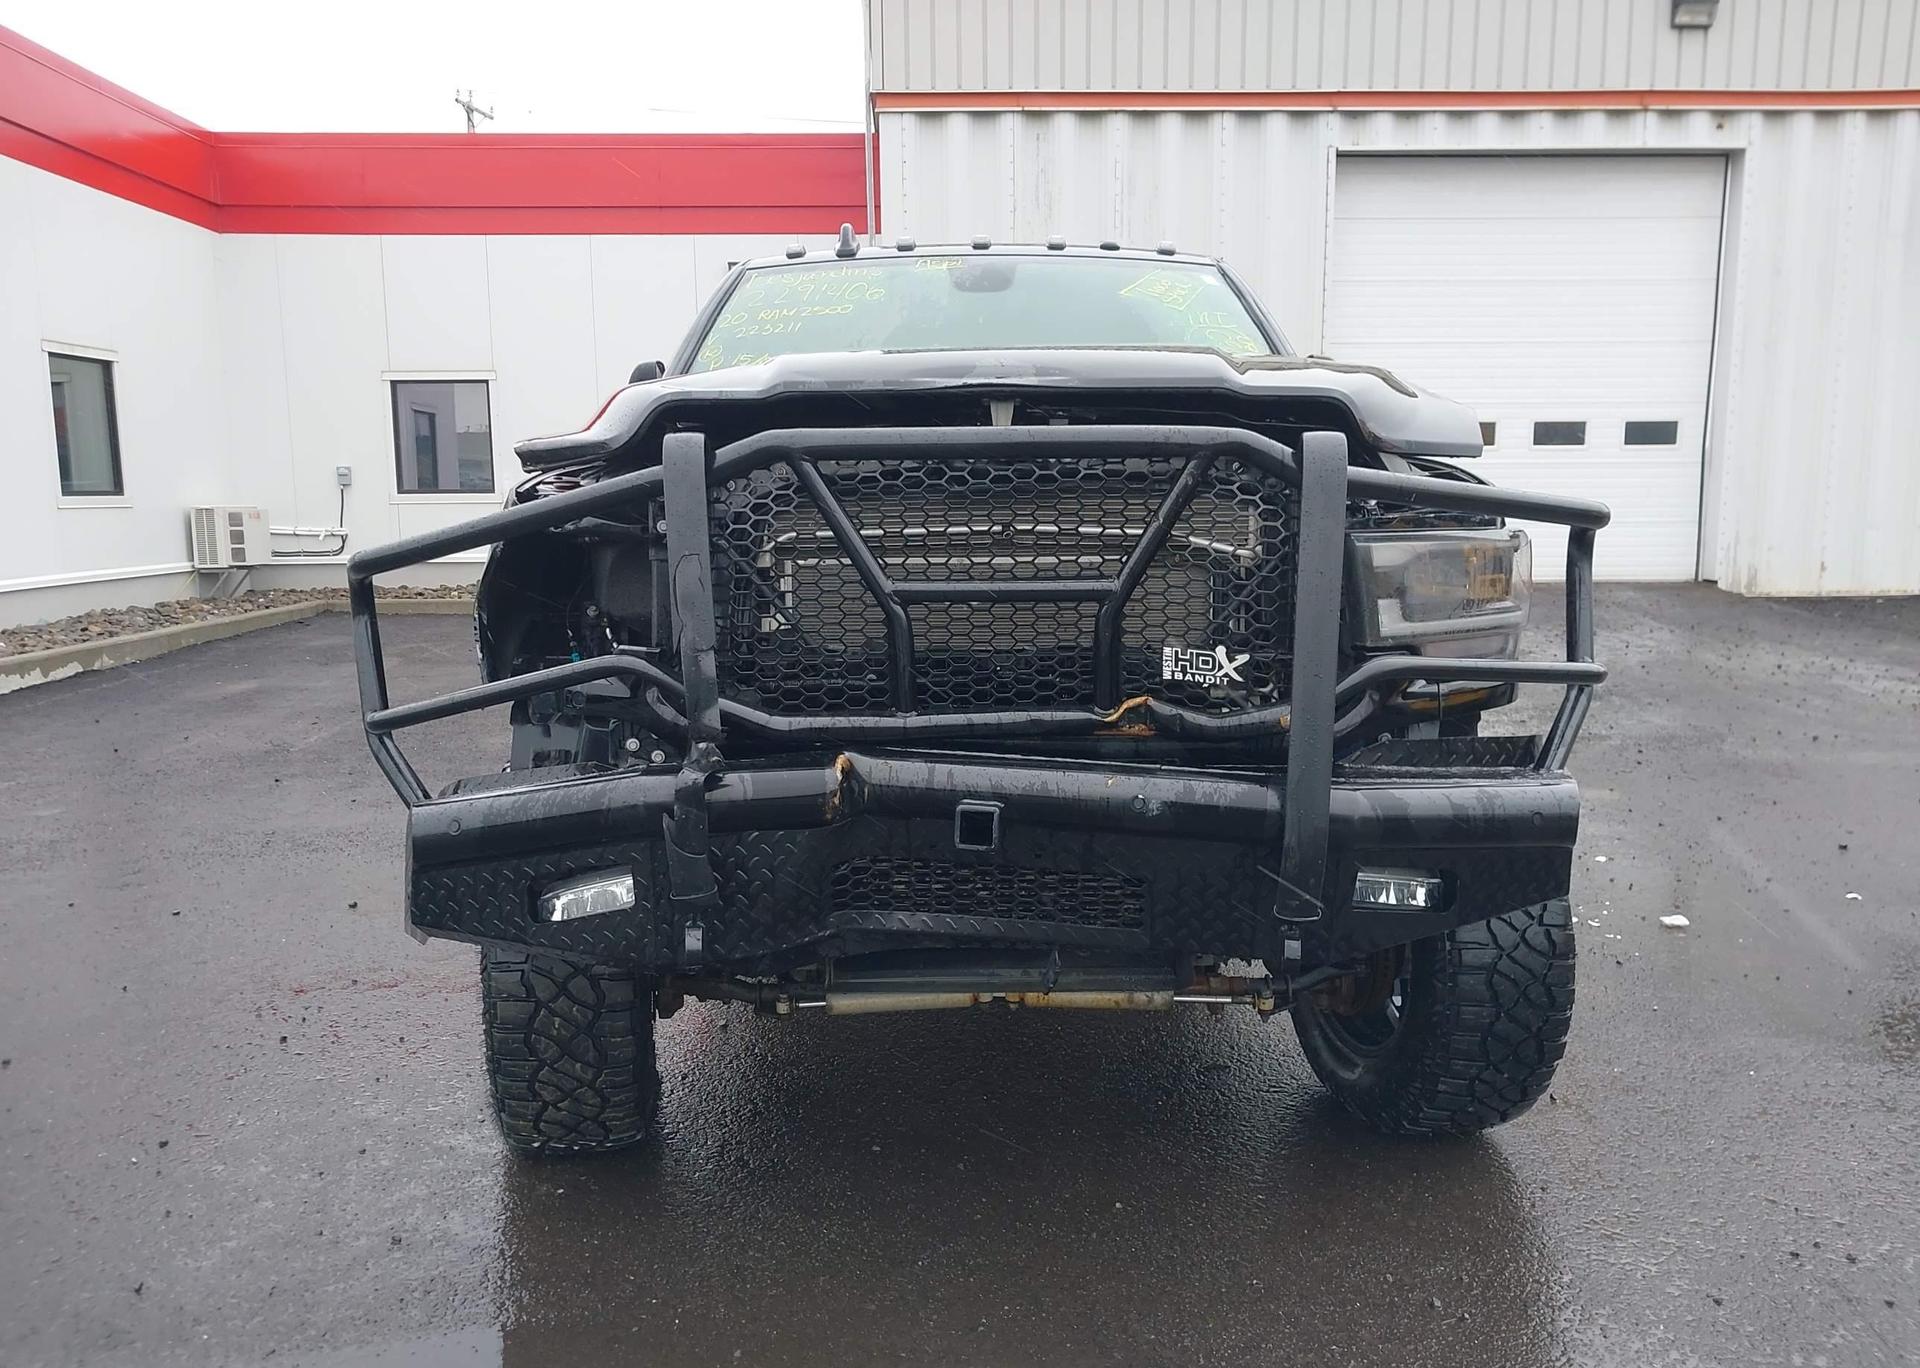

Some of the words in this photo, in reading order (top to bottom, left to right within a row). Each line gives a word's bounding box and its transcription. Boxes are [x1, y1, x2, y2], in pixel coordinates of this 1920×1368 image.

[1163, 646, 1173, 680] WESTIN
[1172, 645, 1250, 683] HDX
[1174, 671, 1230, 686] BANDIT
